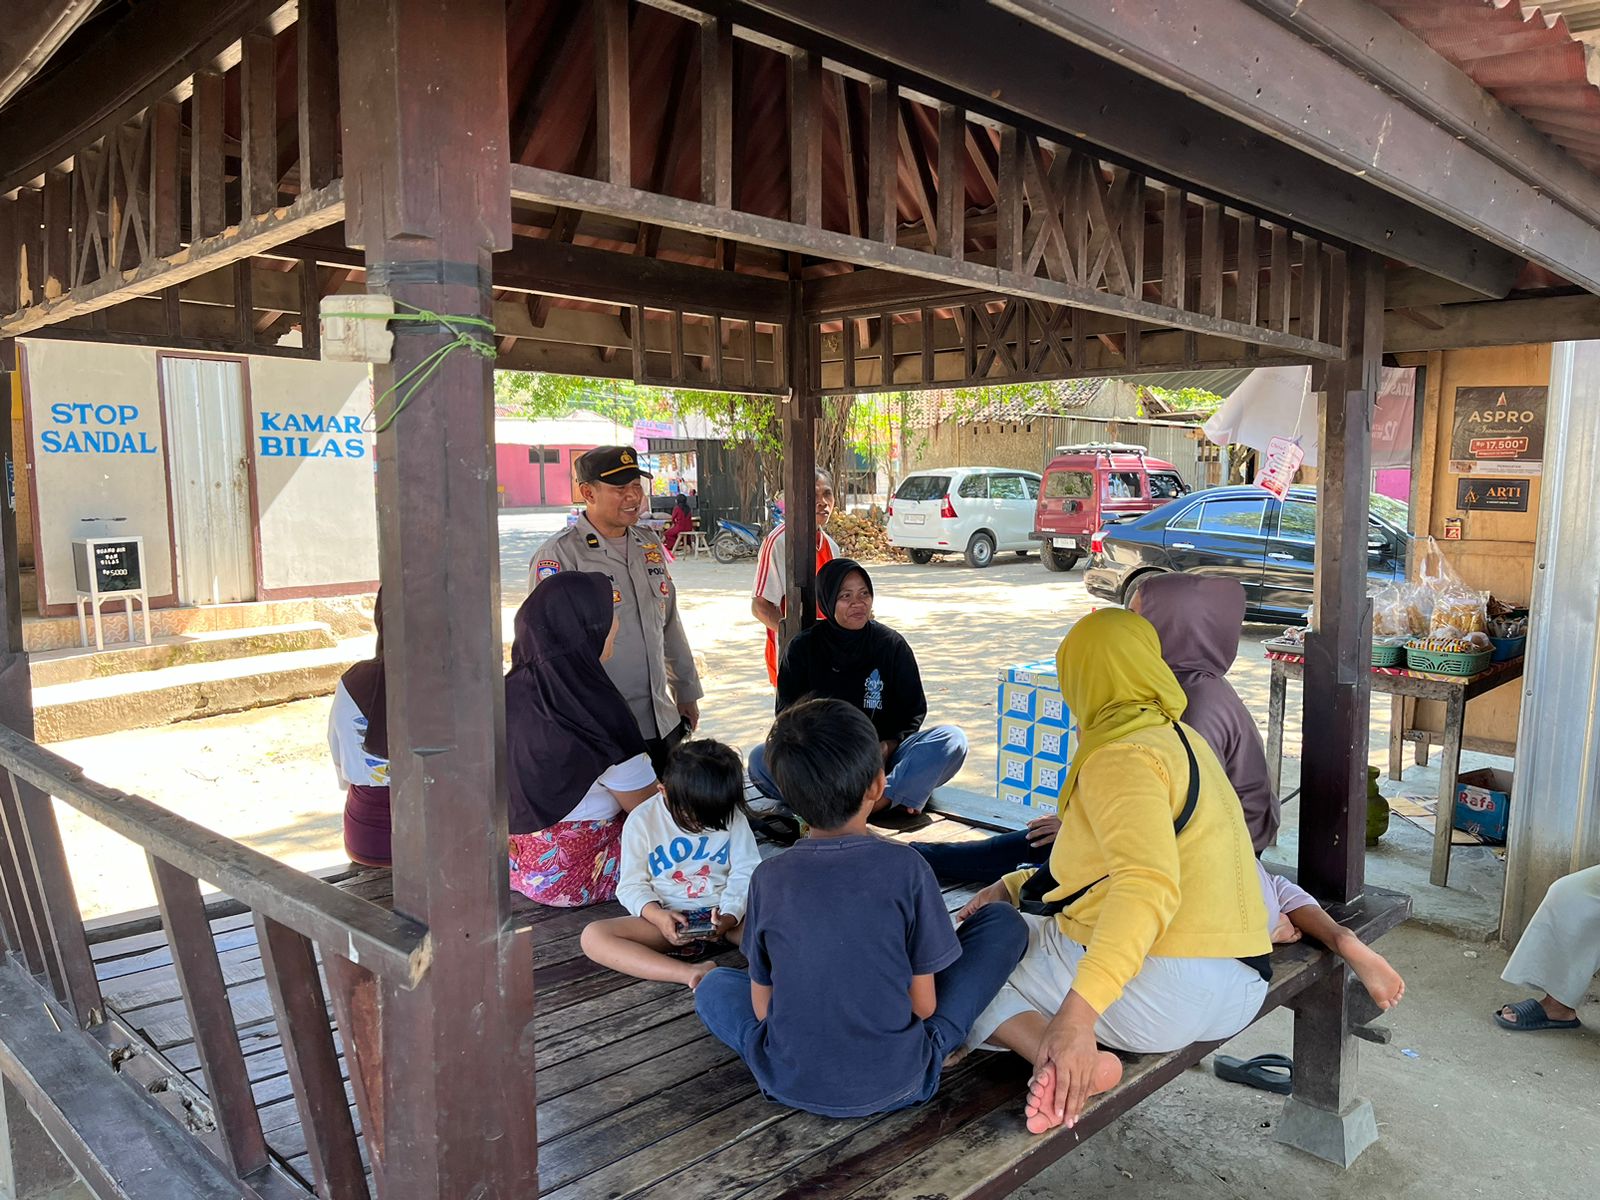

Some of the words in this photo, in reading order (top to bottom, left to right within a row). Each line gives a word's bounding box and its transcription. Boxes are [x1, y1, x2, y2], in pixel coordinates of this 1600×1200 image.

[51, 402, 139, 425] STOP
[260, 411, 363, 434] KAMAR
[1468, 410, 1534, 423] ASPRO
[41, 430, 157, 454] SANDAL
[259, 436, 365, 458] BILAS
[1486, 487, 1521, 497] ARTI
[648, 567, 665, 576] POL
[1459, 792, 1495, 810] Rafa
[649, 836, 731, 877] HOLA
